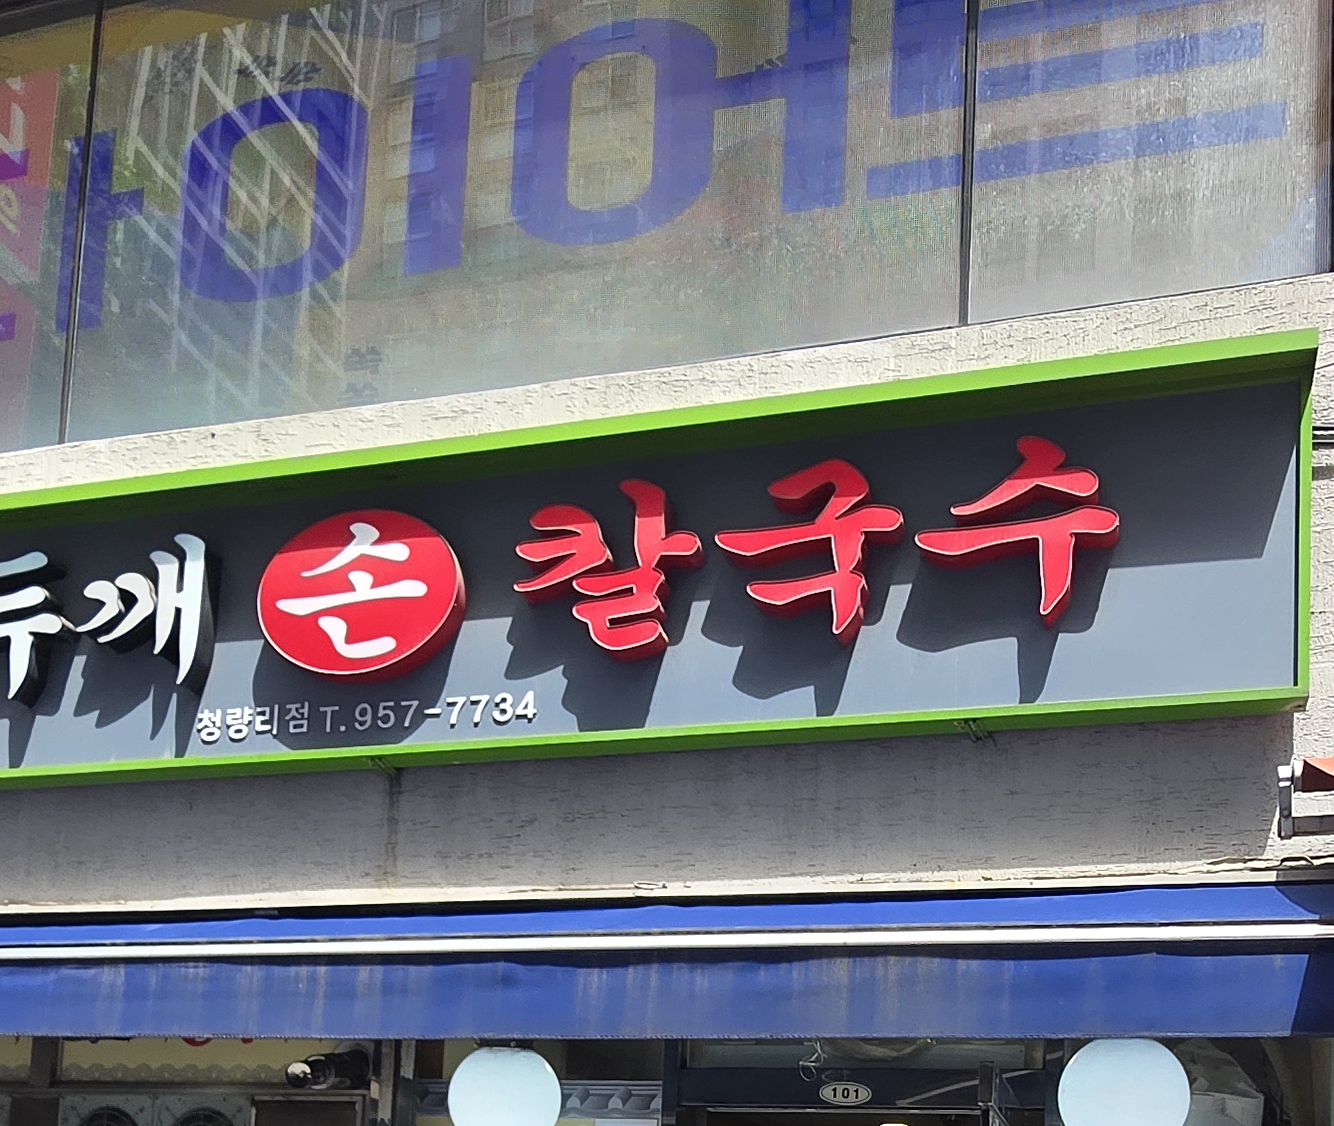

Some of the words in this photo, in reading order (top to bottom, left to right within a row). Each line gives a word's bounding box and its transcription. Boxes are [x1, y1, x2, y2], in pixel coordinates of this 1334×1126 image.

[274, 521, 430, 660] 손
[513, 435, 1121, 655] 칼국수
[195, 702, 310, 743] 청량리점
[831, 1086, 861, 1100] 101
